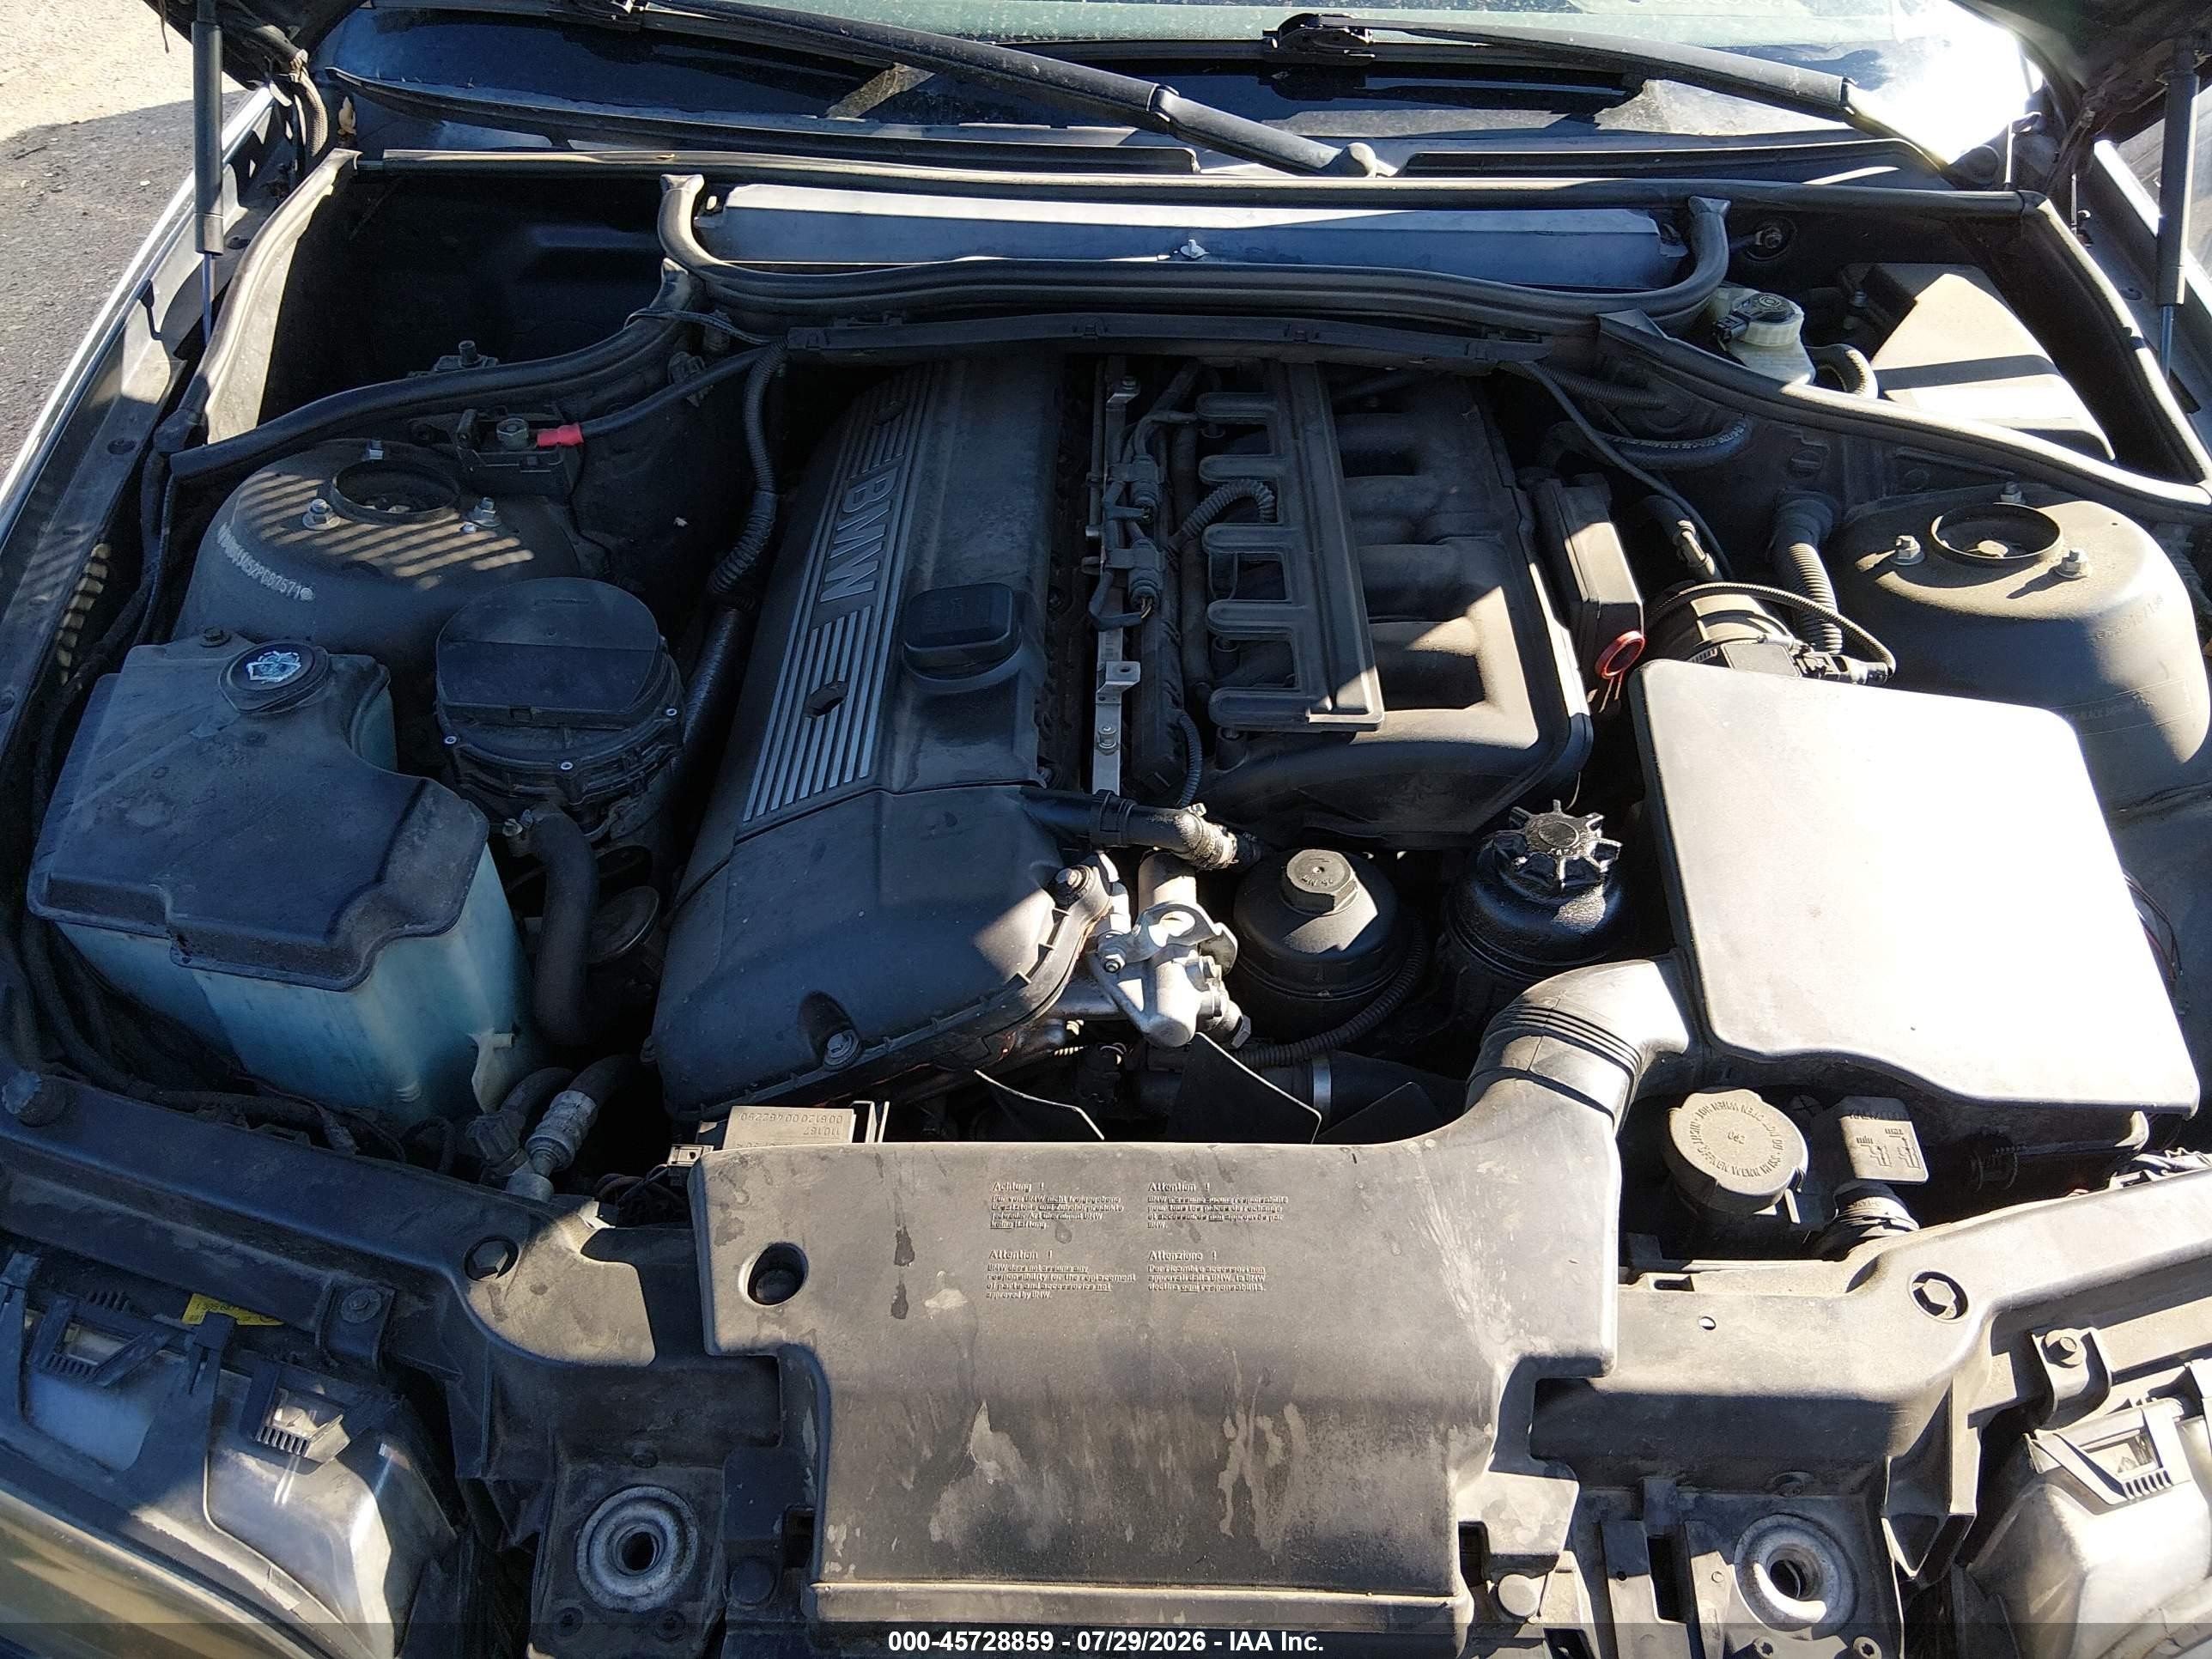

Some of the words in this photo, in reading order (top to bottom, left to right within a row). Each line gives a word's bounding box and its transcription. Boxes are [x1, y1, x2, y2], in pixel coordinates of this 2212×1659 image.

[821, 466, 898, 602] BMW
[1698, 1104, 1713, 1120] HOT
[1712, 1101, 1740, 1112] WHEN
[993, 1182, 1031, 1193] Achtung
[1148, 1182, 1196, 1192] Attention
[989, 1249, 1038, 1260] Attention
[1148, 1250, 1203, 1261] Attenzione
[1080, 1273, 1136, 1282] replacement
